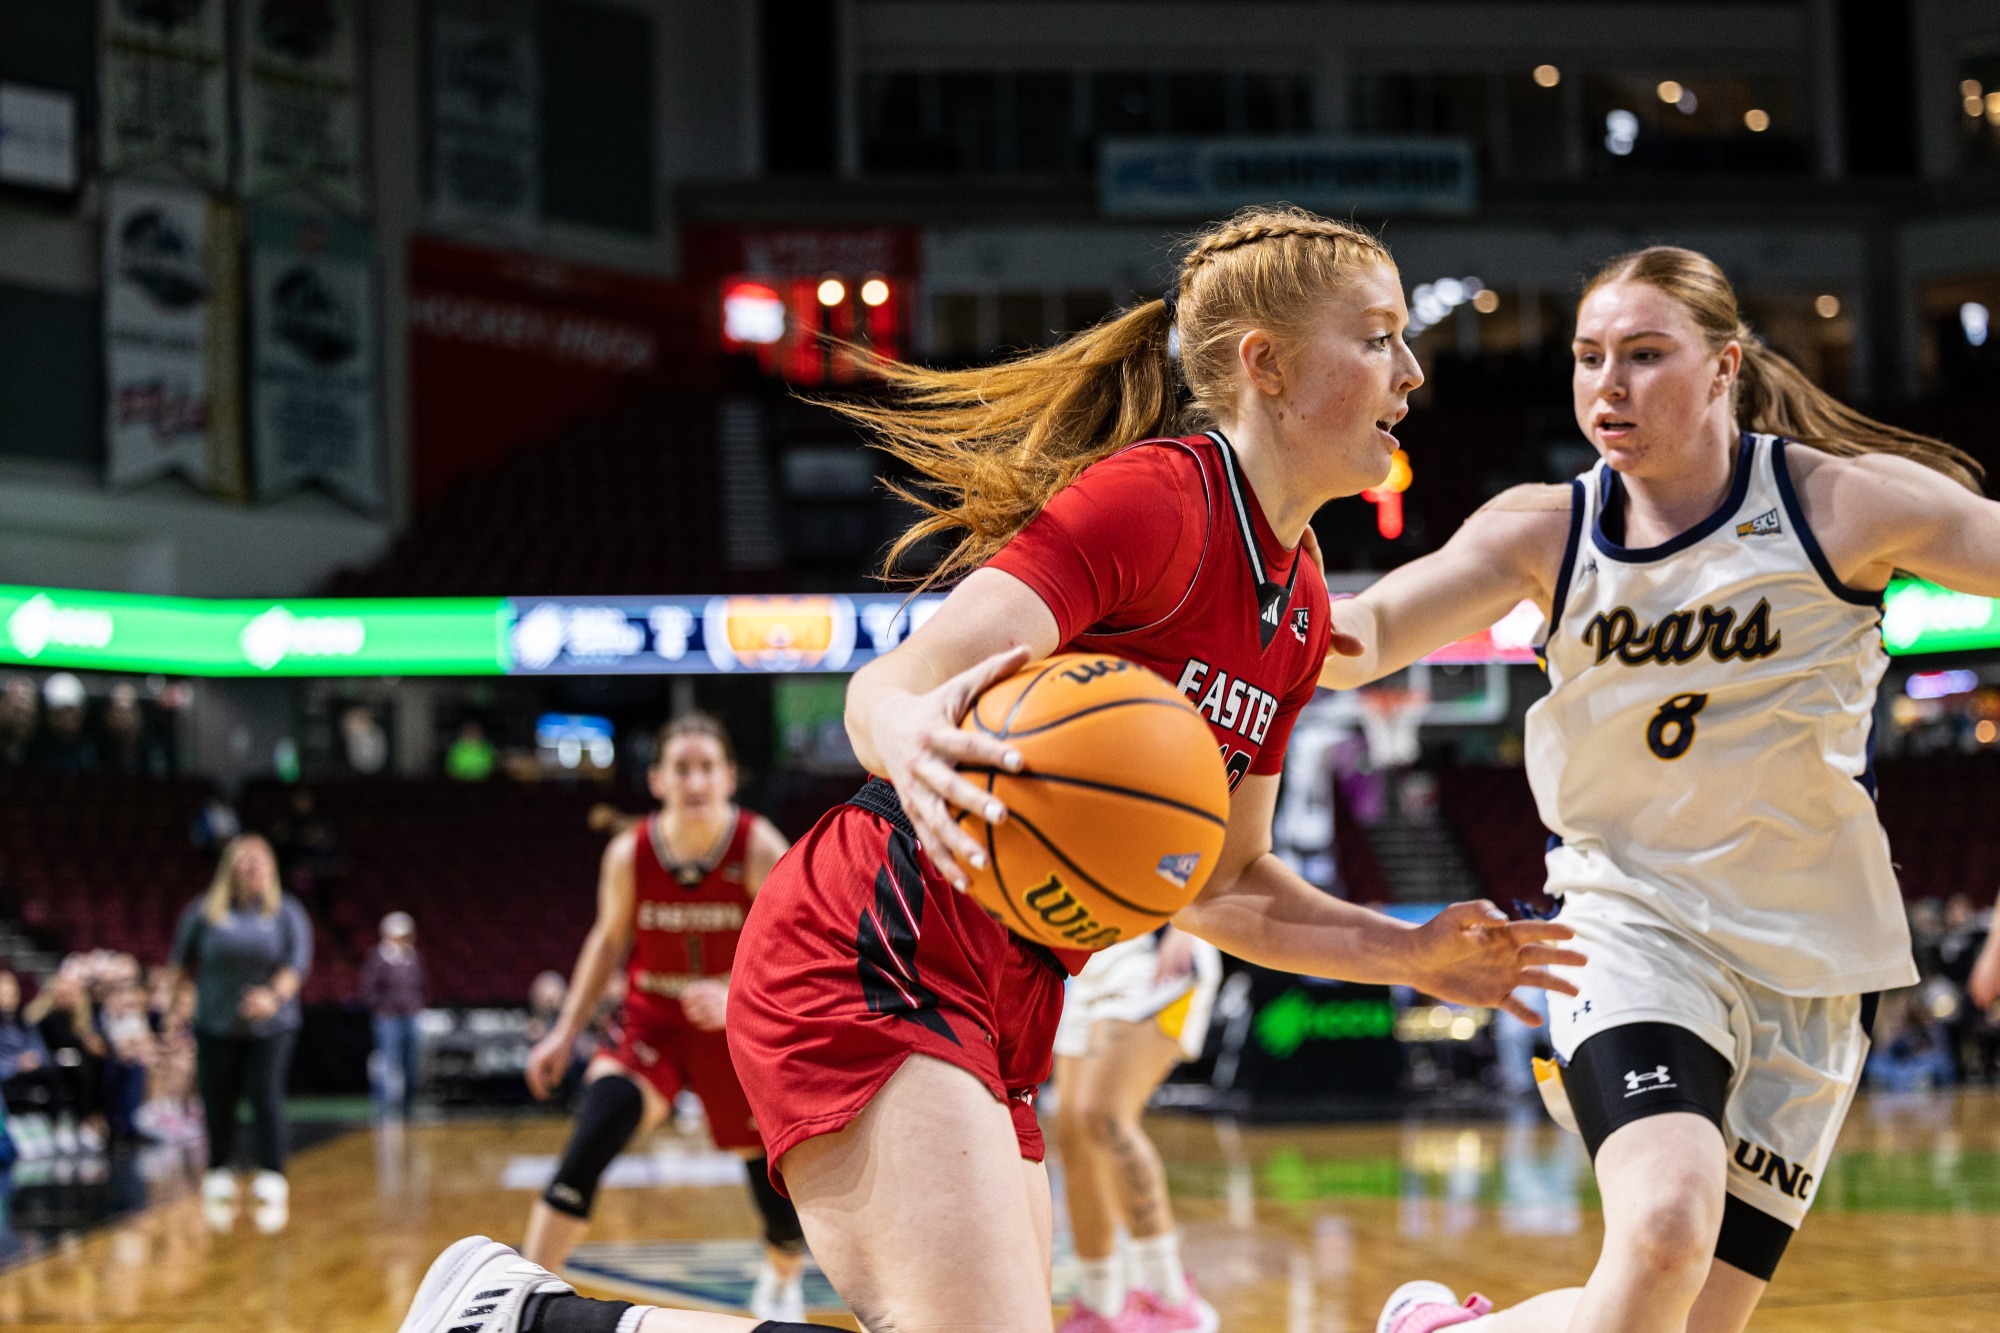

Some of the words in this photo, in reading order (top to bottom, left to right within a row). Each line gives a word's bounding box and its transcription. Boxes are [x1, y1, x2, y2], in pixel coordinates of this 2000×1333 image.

[1753, 510, 1779, 532] SKY
[1647, 692, 1710, 761] 8
[1023, 870, 1121, 944] Wil
[1734, 1138, 1812, 1201] UNC
